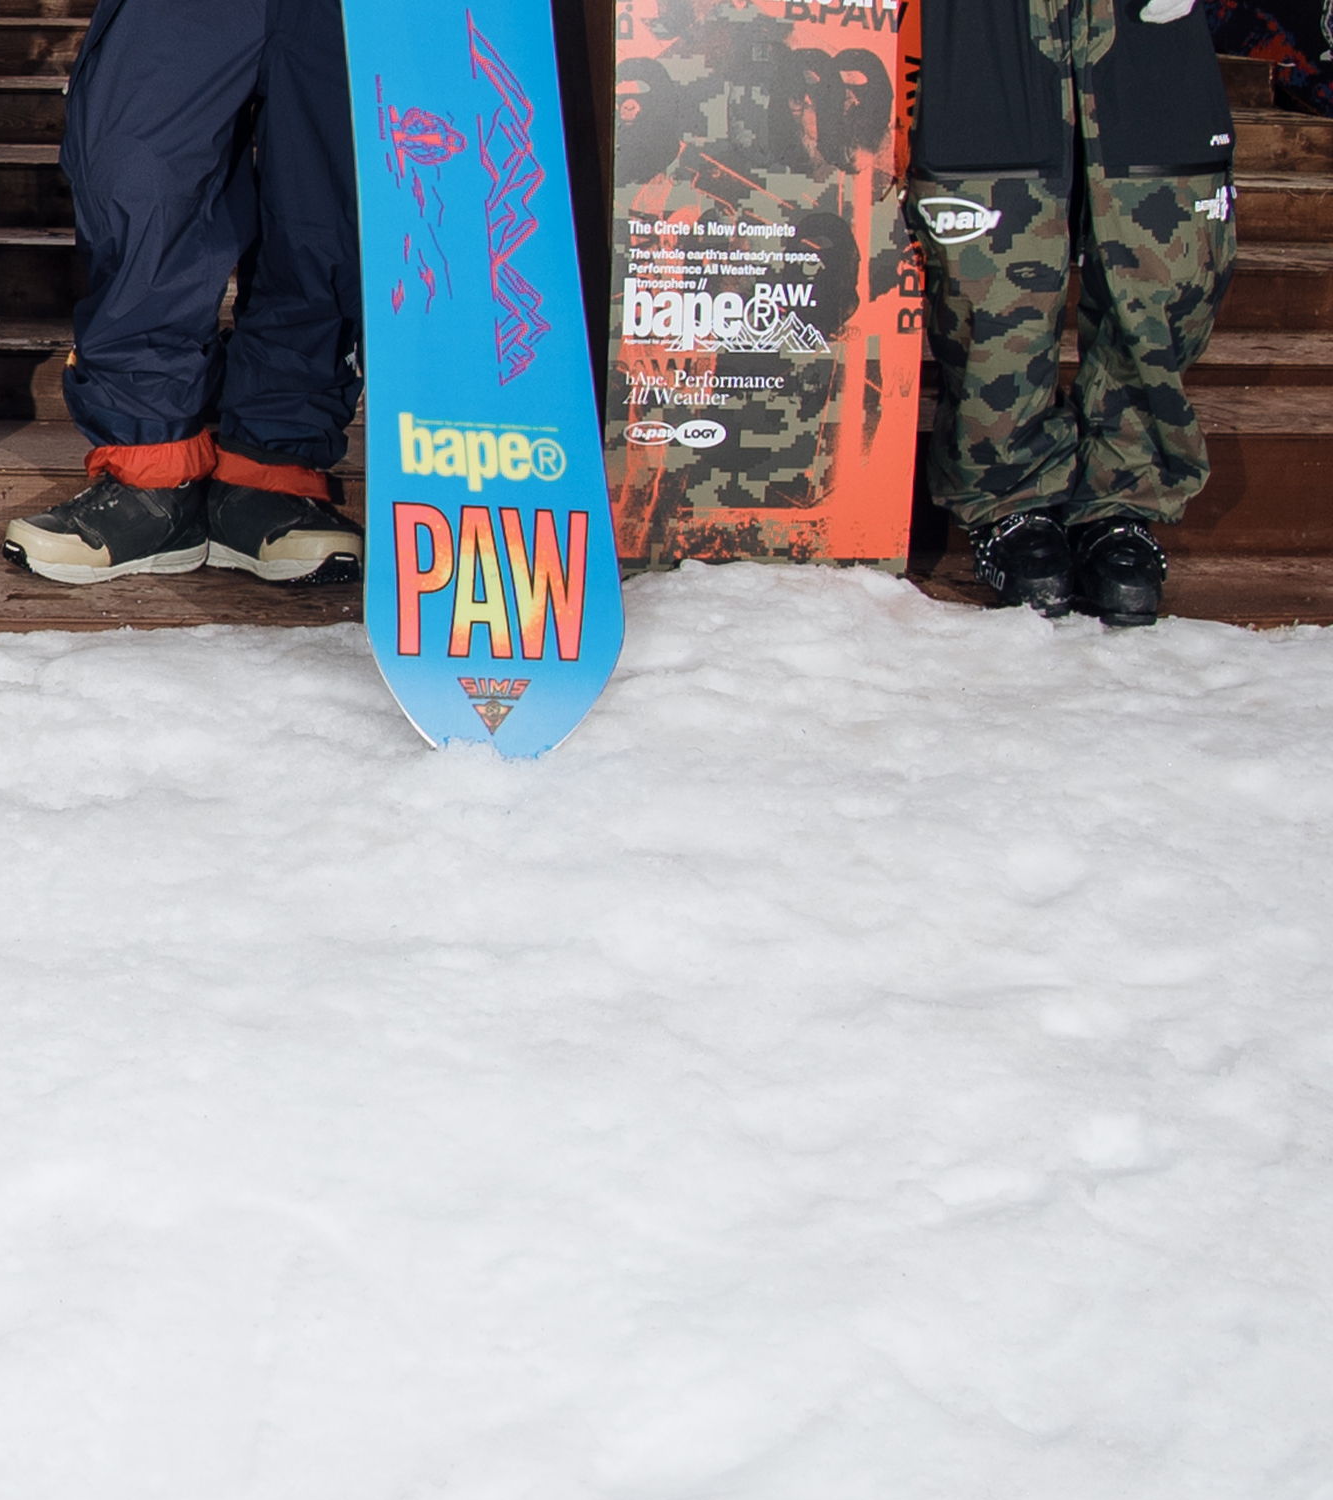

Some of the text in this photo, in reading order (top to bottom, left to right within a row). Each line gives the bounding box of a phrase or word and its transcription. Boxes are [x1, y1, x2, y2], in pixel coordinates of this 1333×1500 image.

[628, 220, 796, 239] The Circle Is Now Complete
[628, 248, 652, 260] The
[652, 249, 686, 260] whole
[784, 252, 820, 264] space.
[628, 263, 767, 276] Performance All Weather
[635, 278, 696, 290] tmosphere
[755, 283, 817, 307] PAW.
[673, 370, 784, 389] Performance
[623, 387, 730, 406] All Weather
[684, 428, 718, 439] LOGY
[392, 501, 590, 662] PAW
[457, 677, 532, 696] SIMS
